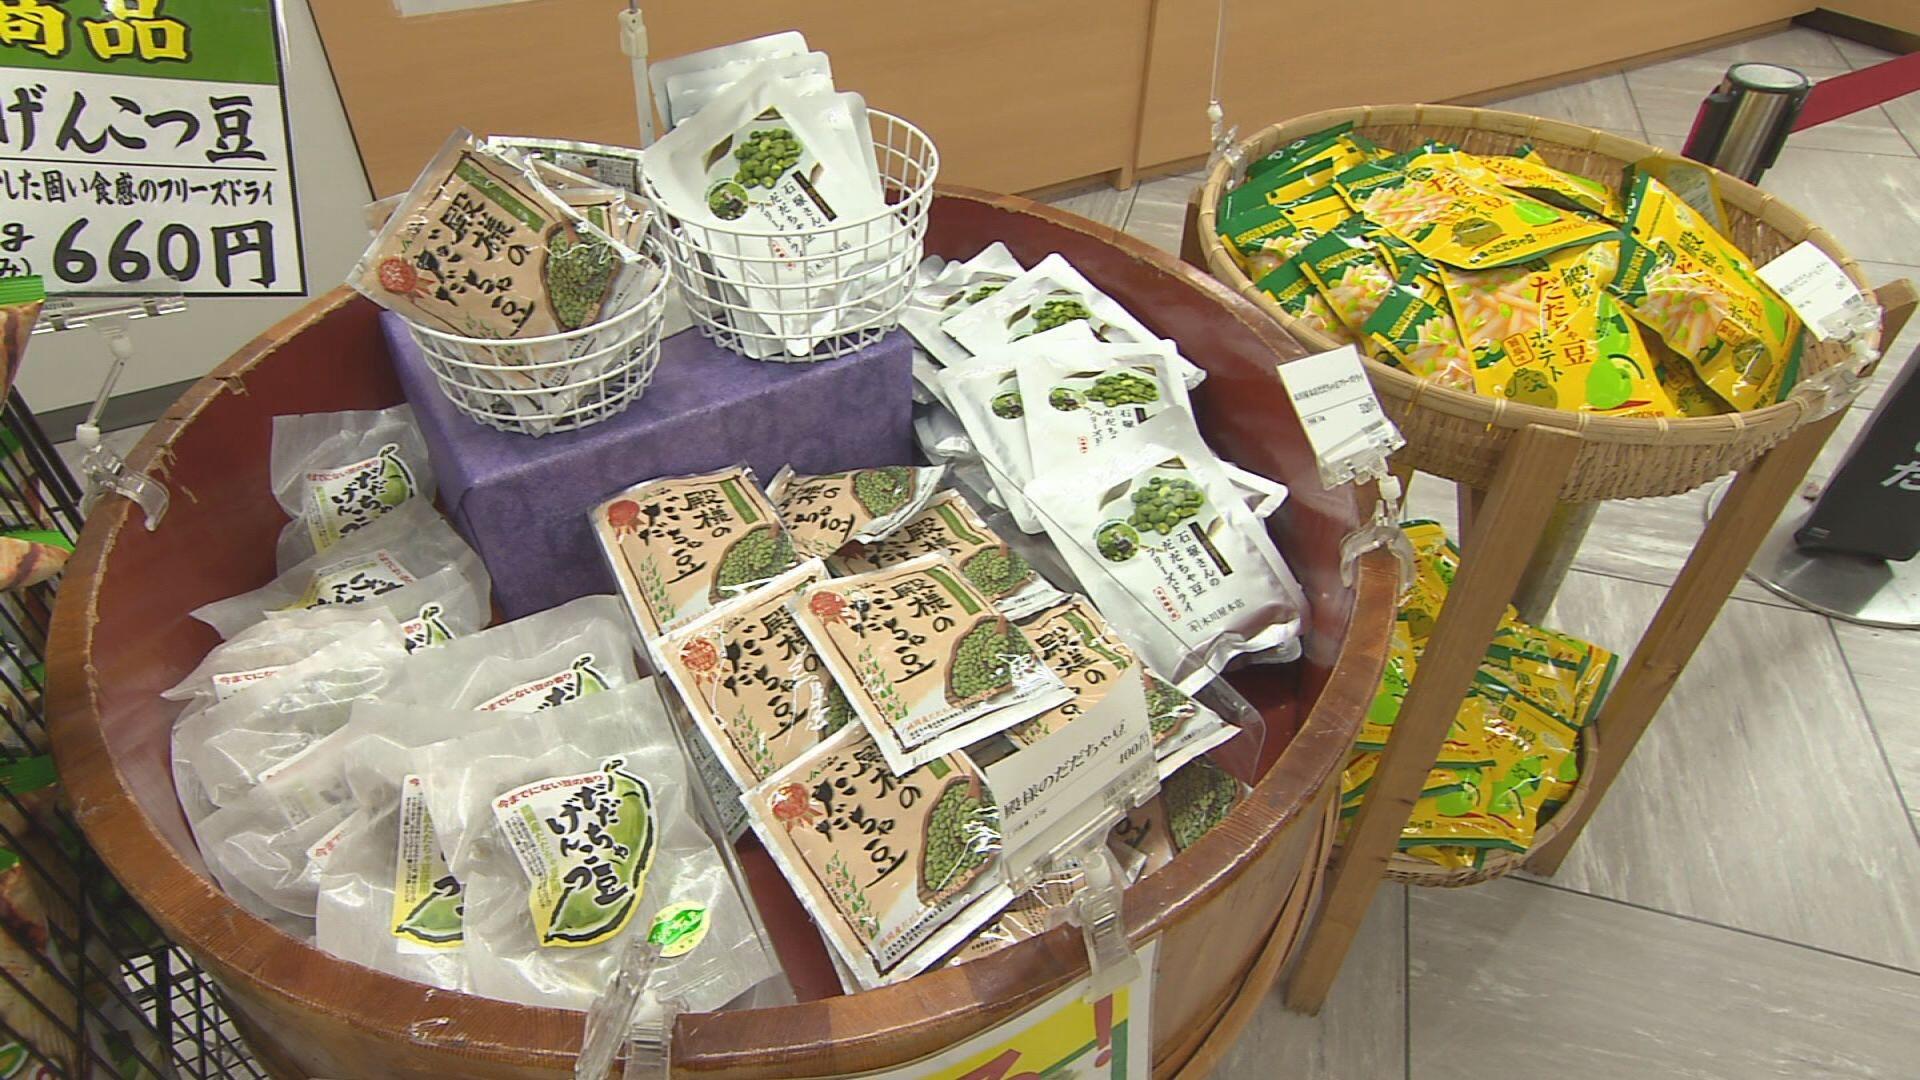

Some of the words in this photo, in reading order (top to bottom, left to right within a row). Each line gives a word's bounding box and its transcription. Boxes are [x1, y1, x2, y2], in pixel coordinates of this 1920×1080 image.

[0, 84, 267, 163] げんこつ豆
[0, 168, 274, 207] した固い食感のフリーズドライ
[53, 217, 277, 288] 660円
[1530, 276, 1594, 367] だだちゃ豆
[354, 467, 393, 528] だだちゃ
[638, 496, 708, 585] だだちゃ豆
[680, 488, 733, 539] 殿様の
[850, 589, 937, 684] だだちゃ豆
[892, 578, 955, 633] 殿様の
[722, 624, 809, 741] だだちゃ豆
[545, 797, 600, 890] げんこつ
[573, 783, 630, 905] だだちゃ豆
[811, 761, 908, 889] だだちゃ豆
